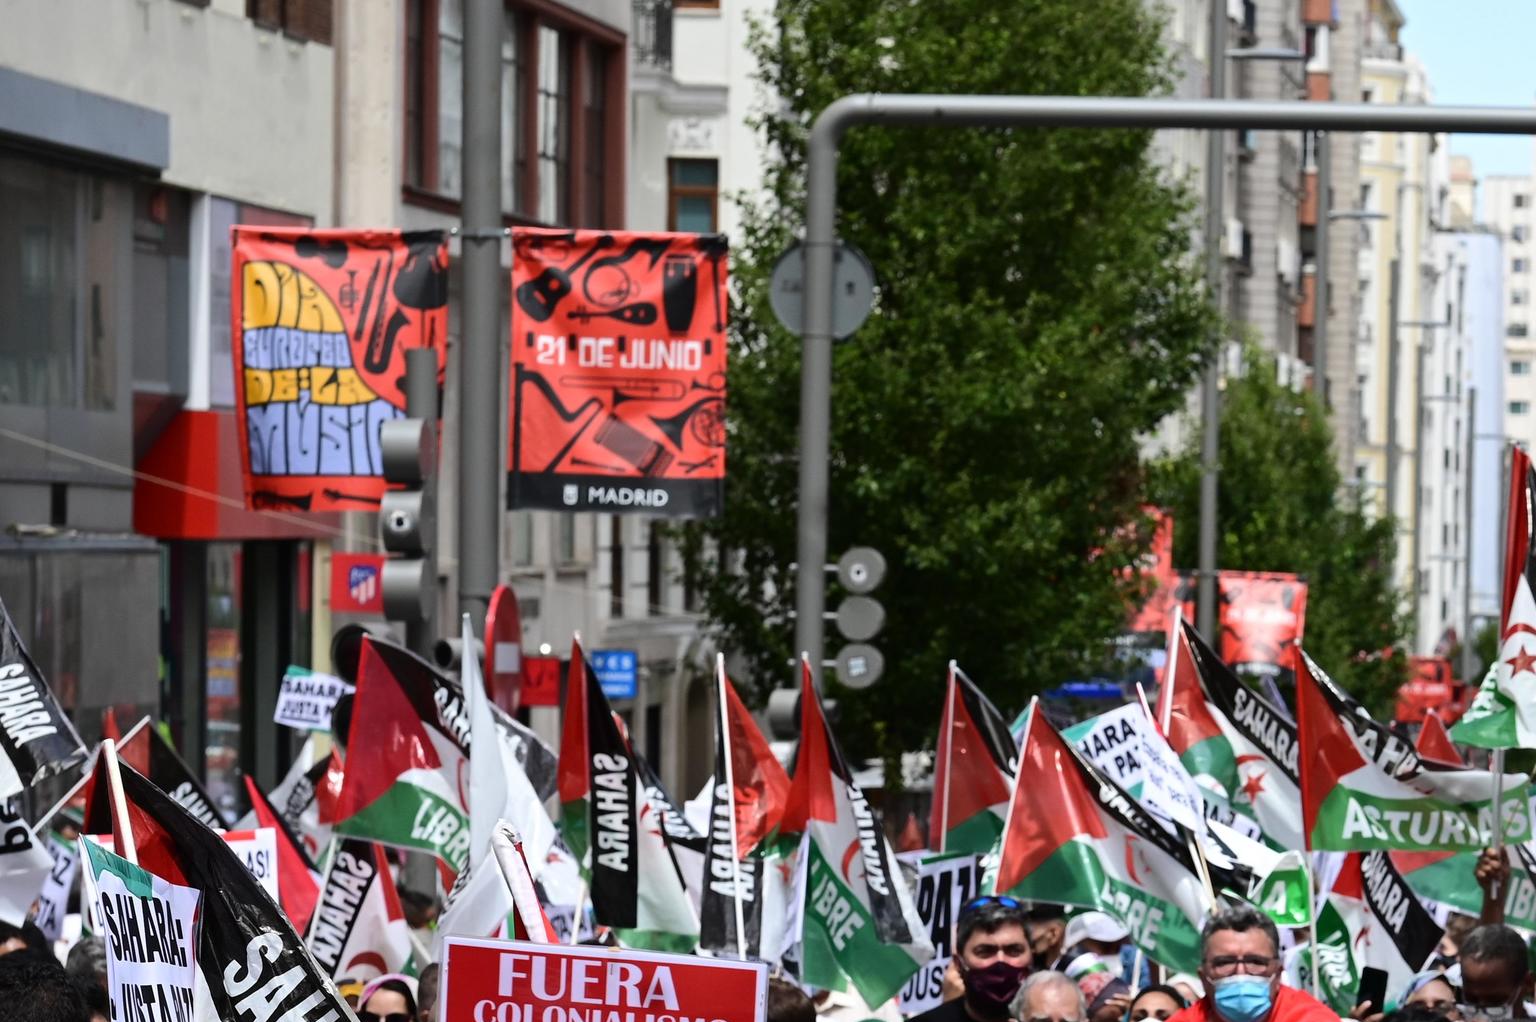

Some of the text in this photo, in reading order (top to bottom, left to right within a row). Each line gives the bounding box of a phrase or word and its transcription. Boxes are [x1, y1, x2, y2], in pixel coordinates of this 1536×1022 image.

[536, 335, 702, 371] 21 DE JUNIO
[587, 486, 669, 507] MADRID
[1341, 797, 1529, 847] ASTURIAS
[101, 891, 188, 968] SAHARA:
[498, 951, 681, 1011] FUERA
